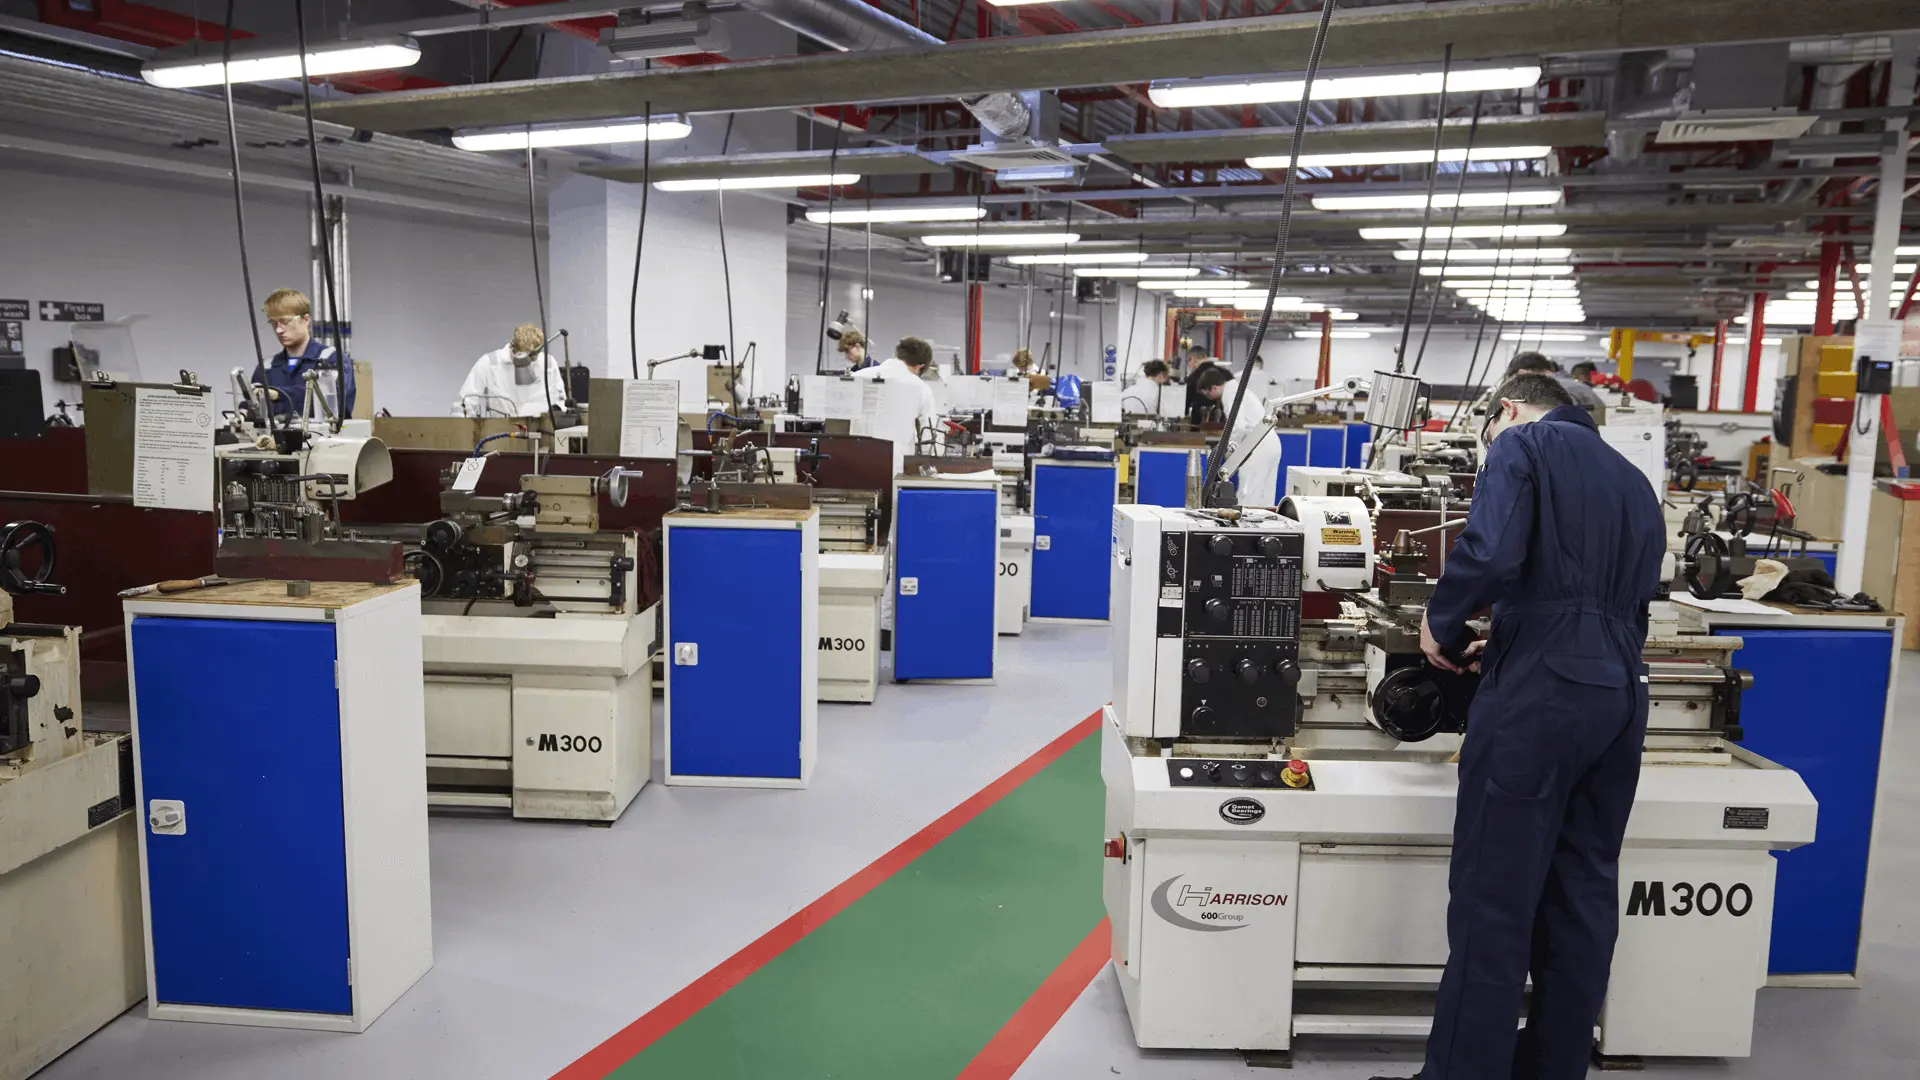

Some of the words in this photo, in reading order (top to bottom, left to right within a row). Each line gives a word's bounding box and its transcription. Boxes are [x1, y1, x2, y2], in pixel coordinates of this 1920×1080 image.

[64, 303, 85, 312] First
[817, 636, 865, 651] M300
[538, 733, 602, 753] M300
[1176, 884, 1288, 907] HARRISON
[1625, 881, 1753, 917] M300
